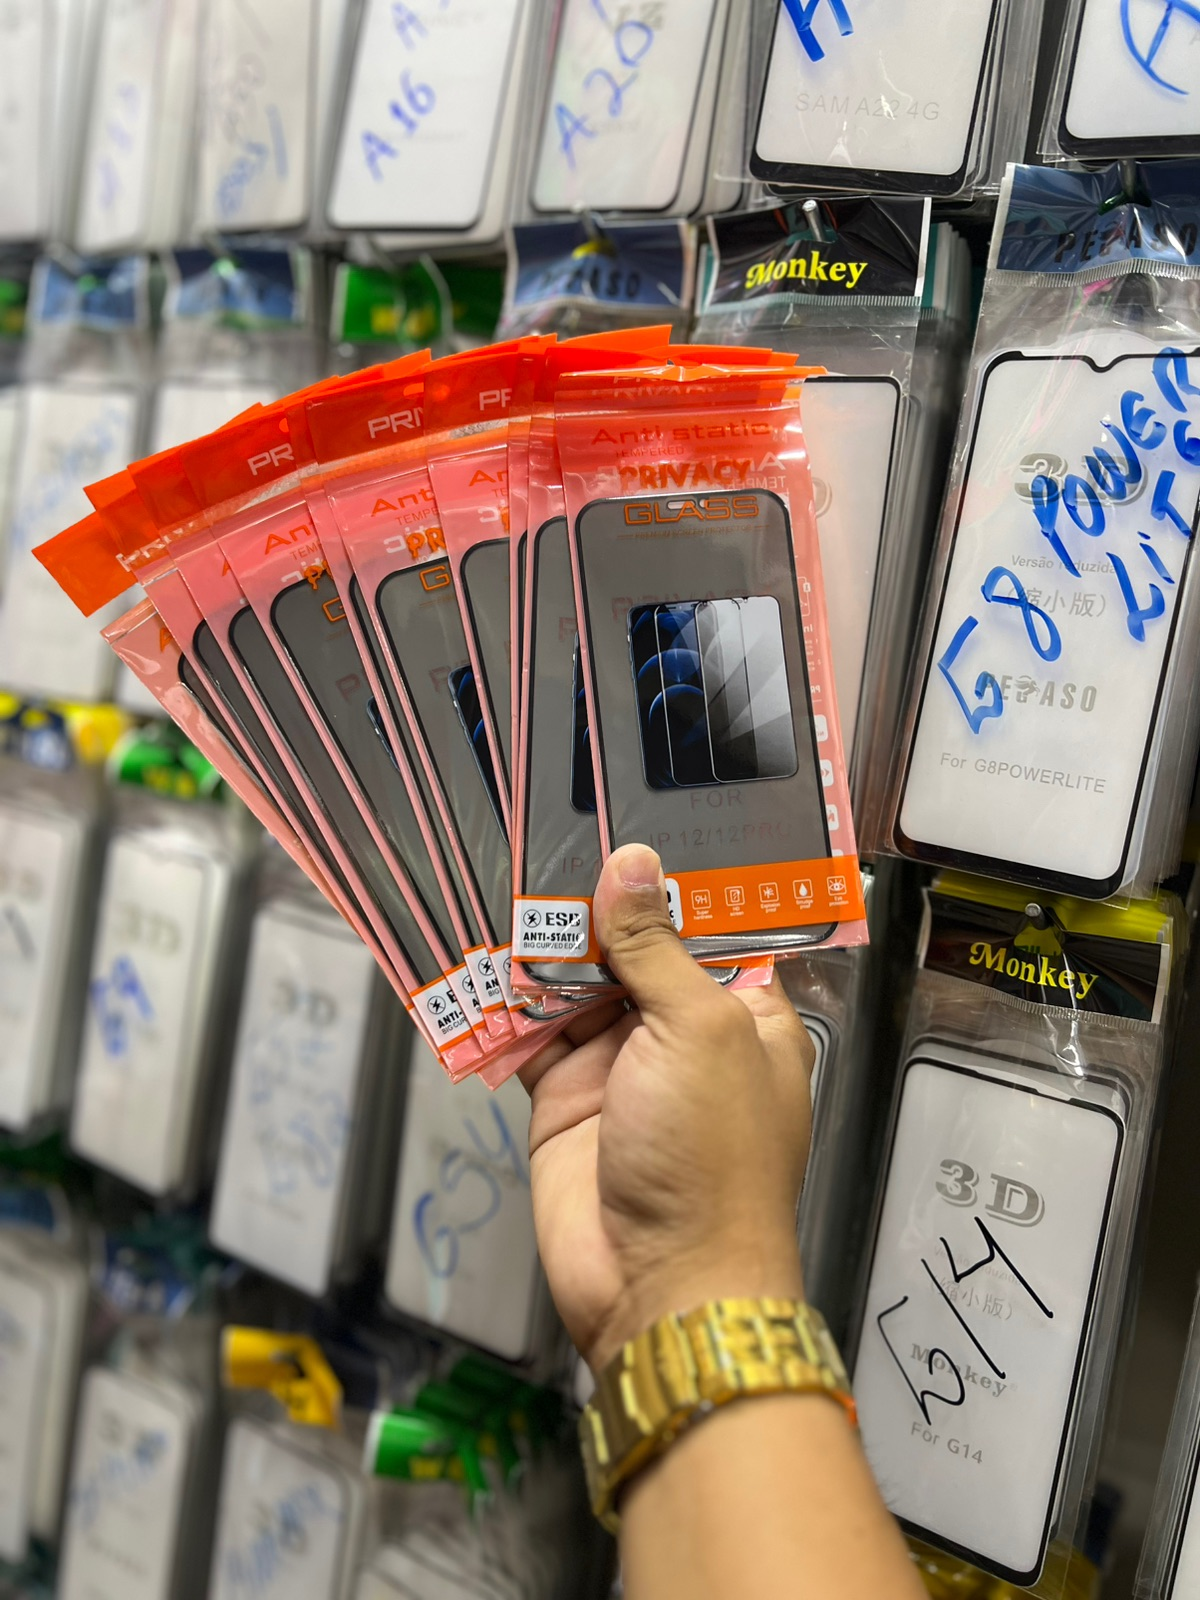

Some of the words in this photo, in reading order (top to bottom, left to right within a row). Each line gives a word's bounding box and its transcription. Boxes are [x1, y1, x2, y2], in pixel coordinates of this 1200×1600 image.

[795, 93, 848, 114] SAM
[854, 95, 900, 118] A22
[905, 100, 940, 121] 4G
[745, 250, 868, 289] Monkey
[591, 424, 661, 446] Anti
[673, 418, 771, 441] static
[616, 444, 685, 460] TEMPERED
[617, 458, 752, 491] PRIVACY
[623, 495, 760, 526] GLASS
[1011, 554, 1055, 570] Versão
[1058, 559, 1116, 575] rduzida
[940, 752, 967, 770] For
[974, 758, 1106, 794] G8POWERLITE
[690, 788, 742, 810] FOR
[694, 894, 708, 905] 9H
[523, 942, 536, 950] BIG
[969, 941, 1099, 1000] Monkey
[935, 1158, 1046, 1228] 3D
[911, 1421, 940, 1446] For
[947, 1437, 984, 1465] G14
